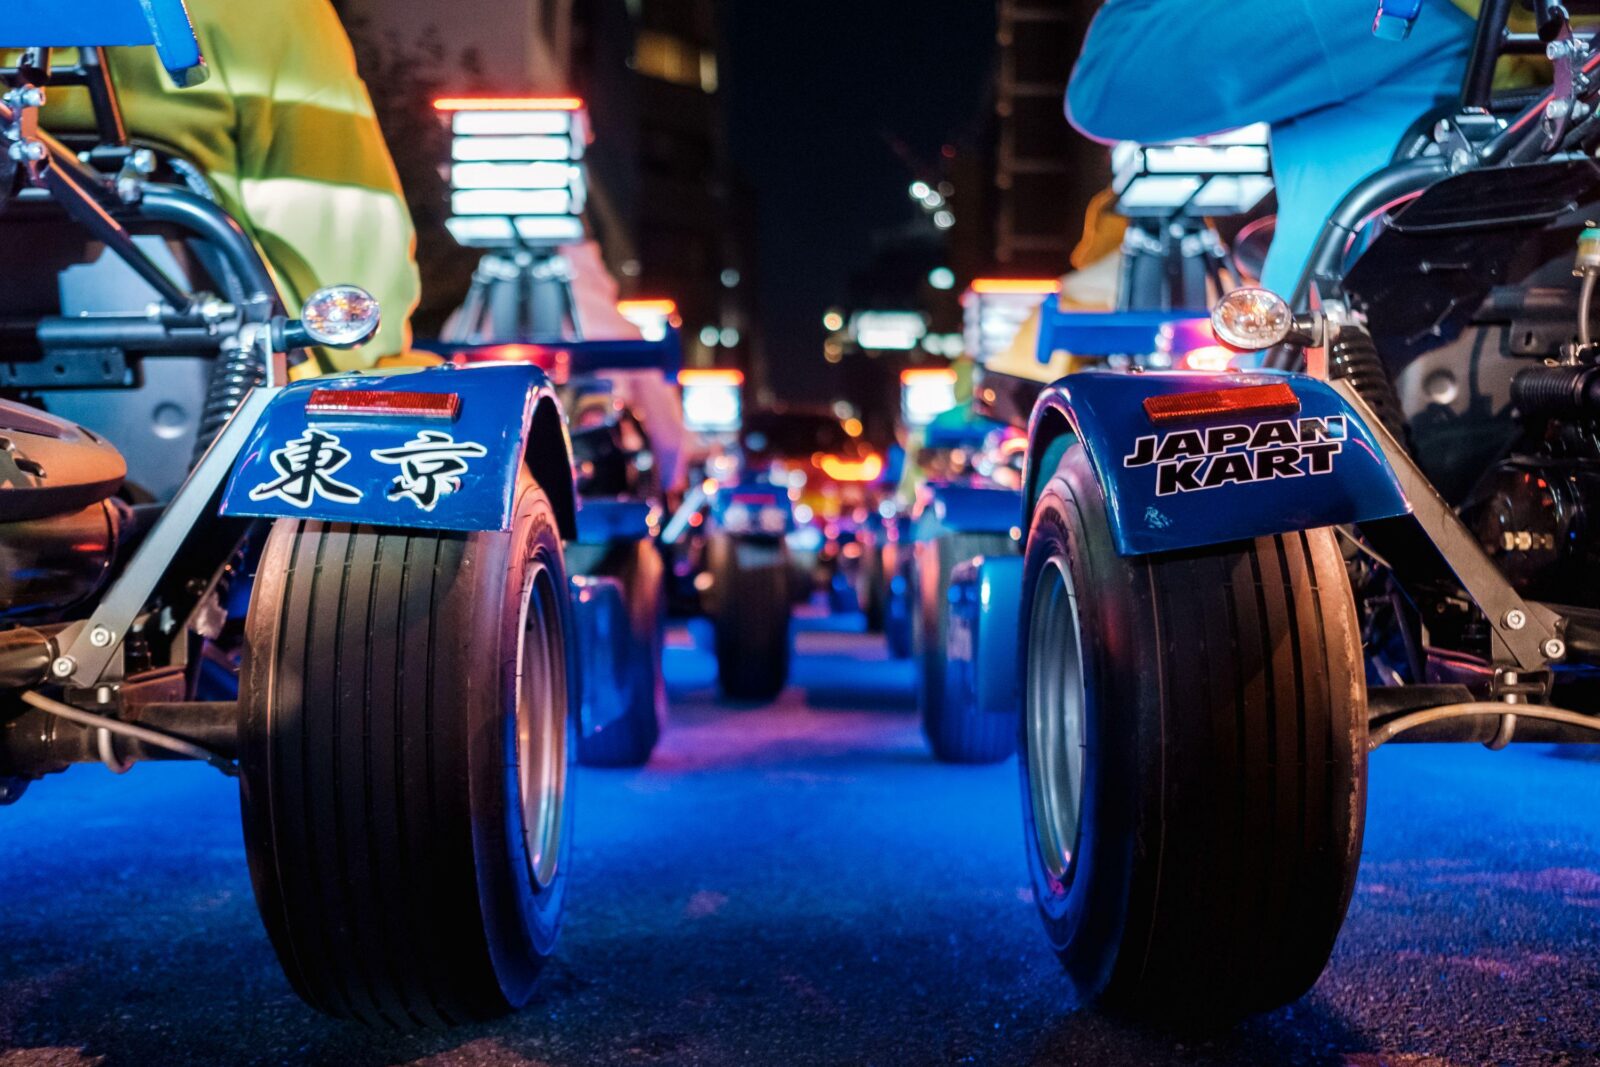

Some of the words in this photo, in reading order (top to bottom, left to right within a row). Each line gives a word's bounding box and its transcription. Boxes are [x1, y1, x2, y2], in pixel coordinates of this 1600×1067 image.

[1125, 416, 1347, 467] JAPAN
[249, 429, 487, 511] 東京
[1156, 442, 1342, 496] KART
